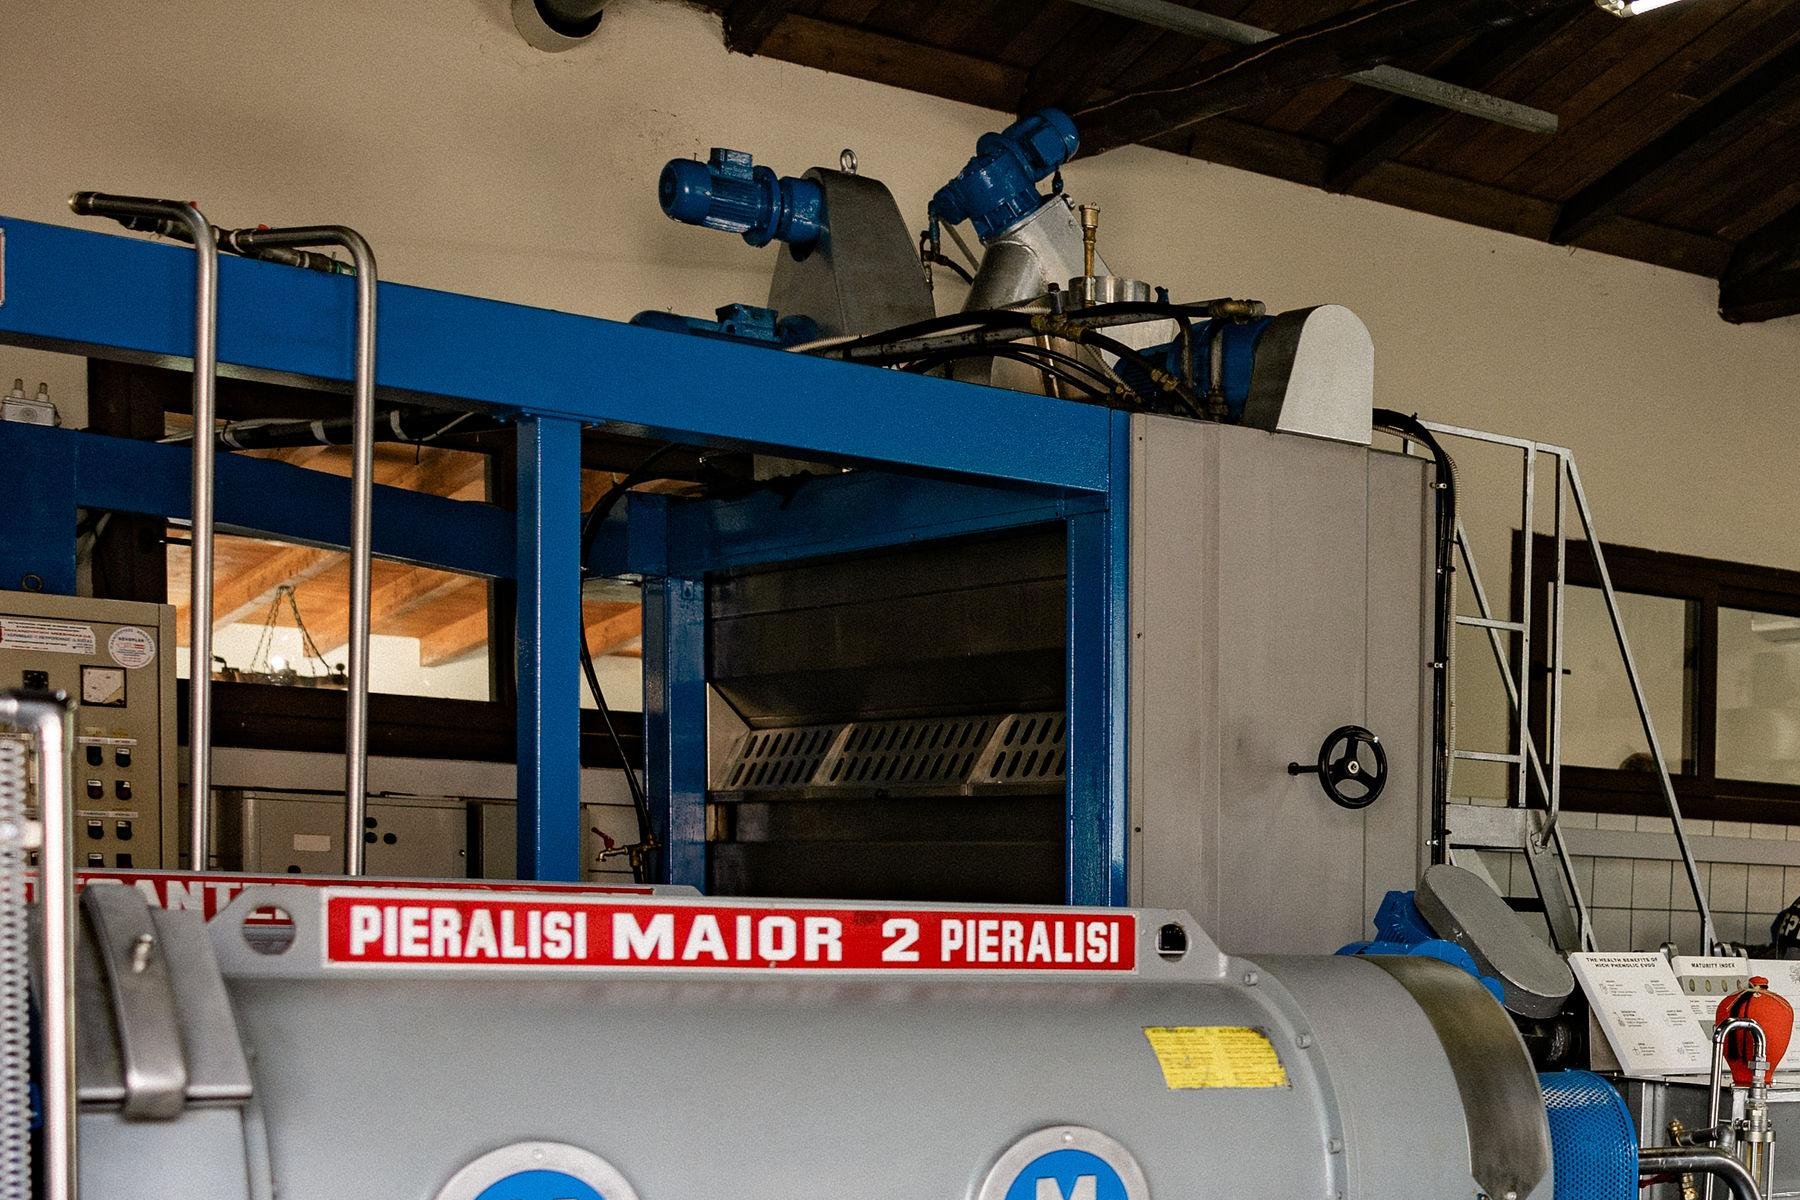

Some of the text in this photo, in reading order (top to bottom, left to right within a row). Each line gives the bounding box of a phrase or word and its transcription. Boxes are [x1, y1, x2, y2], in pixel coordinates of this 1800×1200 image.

[350, 904, 1120, 963] PIERALISI MAIOR 2 PIERALISI
